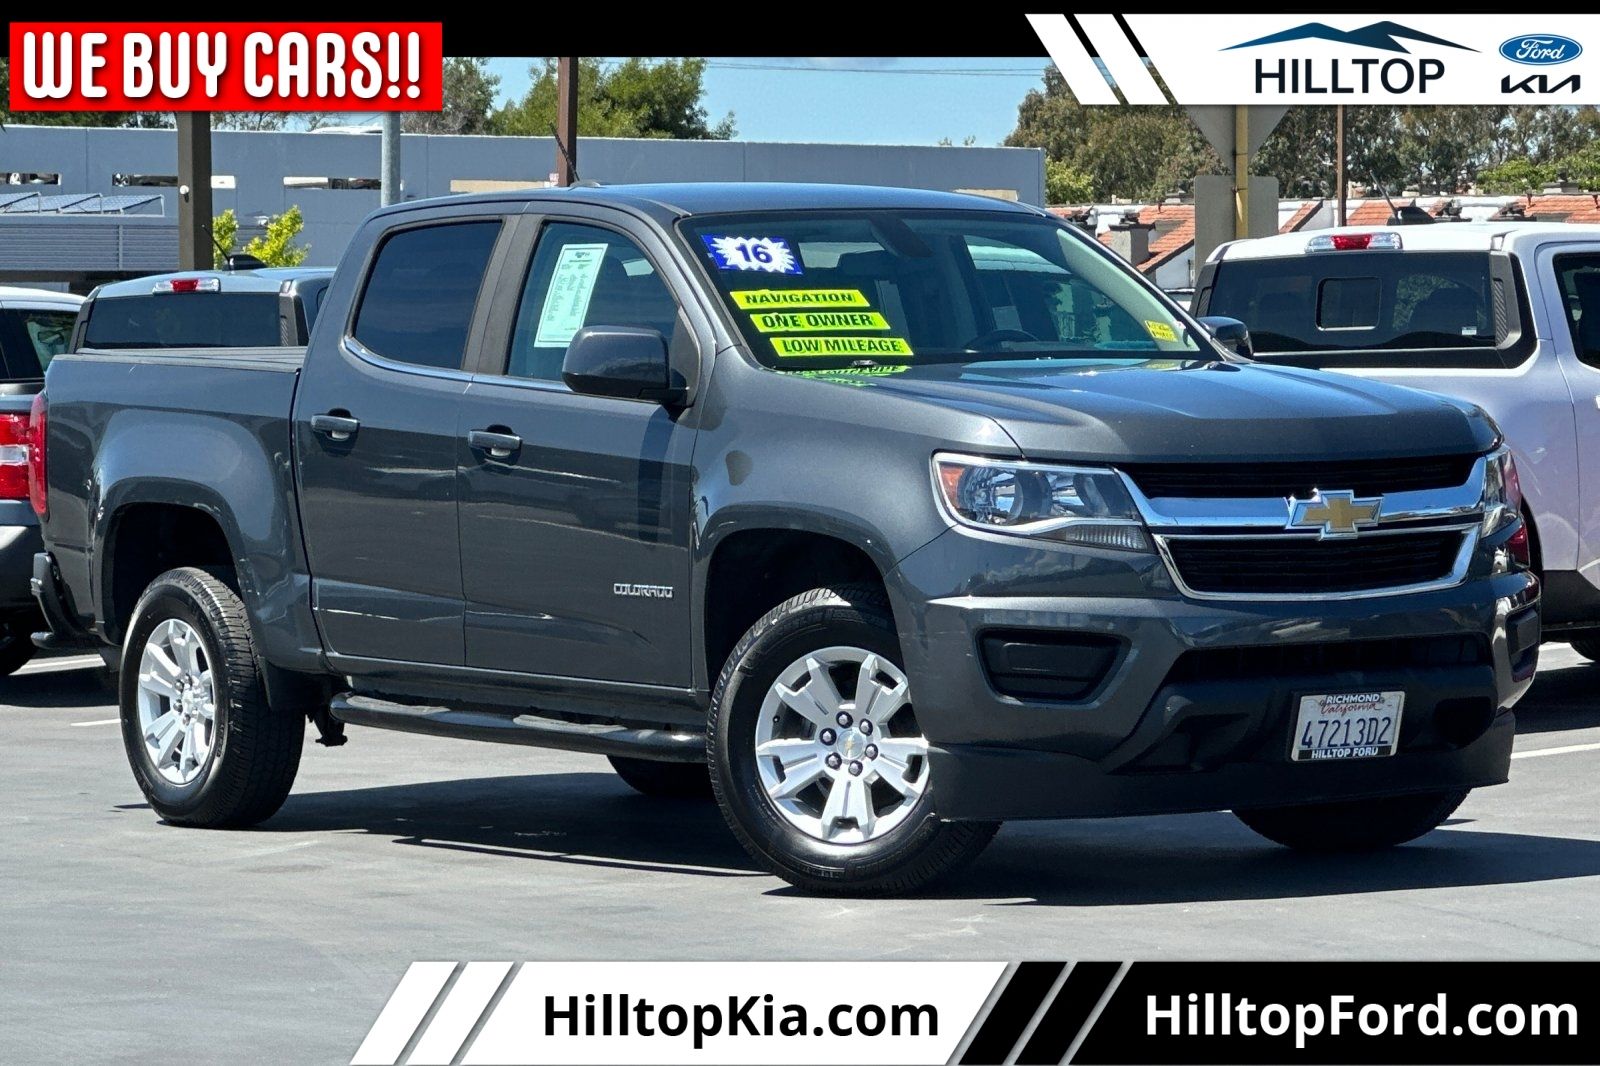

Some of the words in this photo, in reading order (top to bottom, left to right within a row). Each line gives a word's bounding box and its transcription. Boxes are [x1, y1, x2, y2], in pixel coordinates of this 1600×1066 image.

[735, 242, 773, 264] 16
[744, 292, 853, 305] NAVIGATION
[762, 314, 804, 329] ONE
[807, 313, 874, 328] OWNER
[782, 339, 821, 353] LOW
[824, 338, 901, 353] MILEAGE
[613, 583, 674, 598] COLORADO
[1326, 693, 1380, 704] RICHMOND
[1301, 716, 1392, 748] 47213D2
[1311, 748, 1351, 759] HILLTOP
[1352, 747, 1379, 757] FORD
